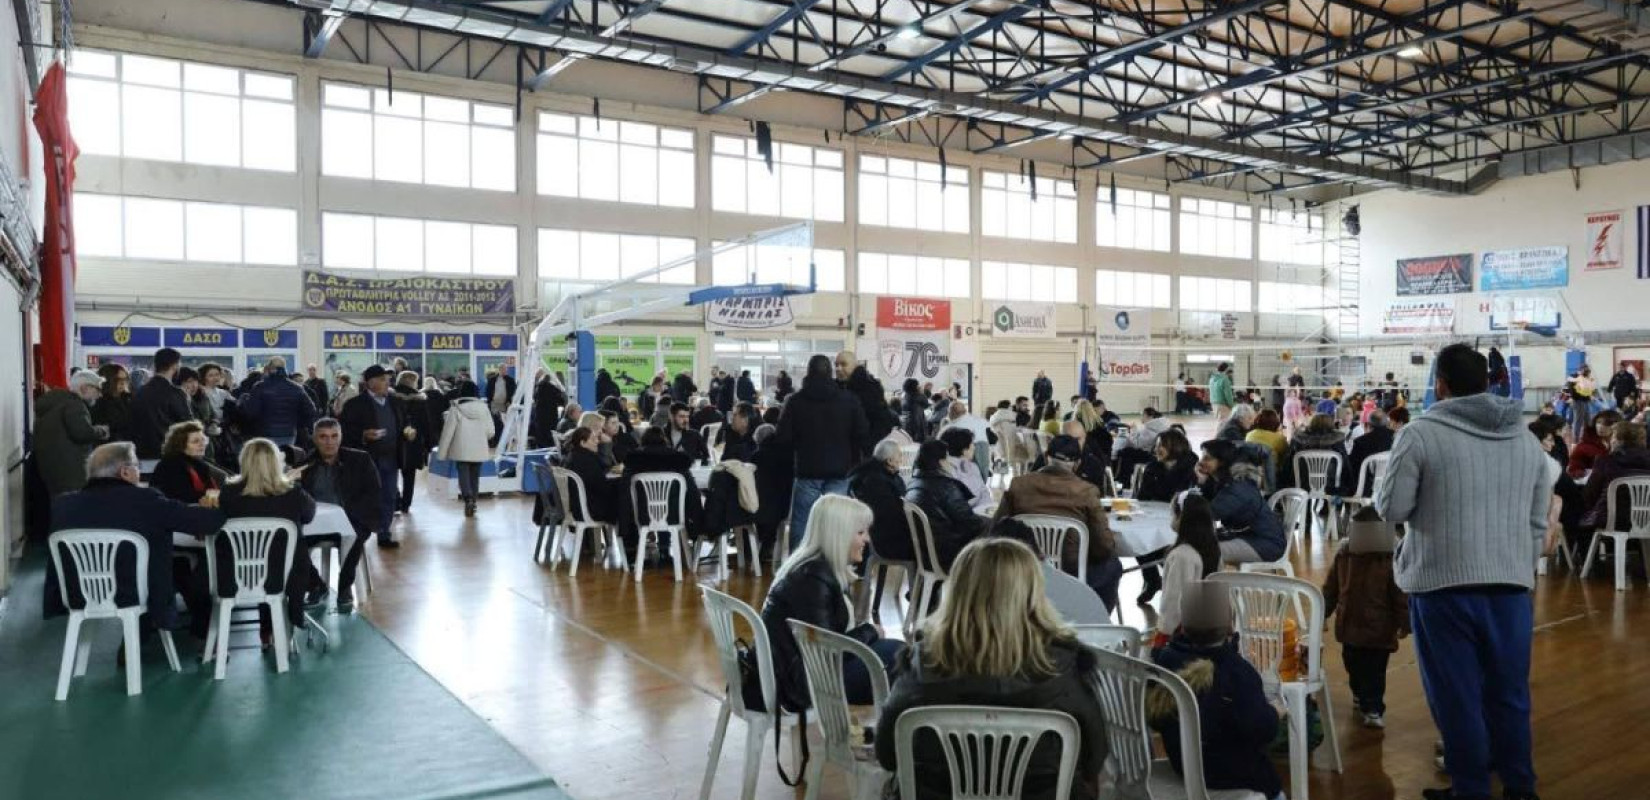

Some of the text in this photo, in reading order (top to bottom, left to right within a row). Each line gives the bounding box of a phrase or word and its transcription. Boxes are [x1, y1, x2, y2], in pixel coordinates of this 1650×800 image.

[338, 300, 393, 313] ΑΝΟΔΟΣ
[420, 303, 484, 314] ΓΥΝΑΙΚΩΝ
[183, 333, 221, 345] ΔΑΣΩ
[331, 333, 367, 348] ΔΑΣΩ
[431, 335, 463, 349] ΔΑΣΩ
[1109, 362, 1151, 376] TopGas
